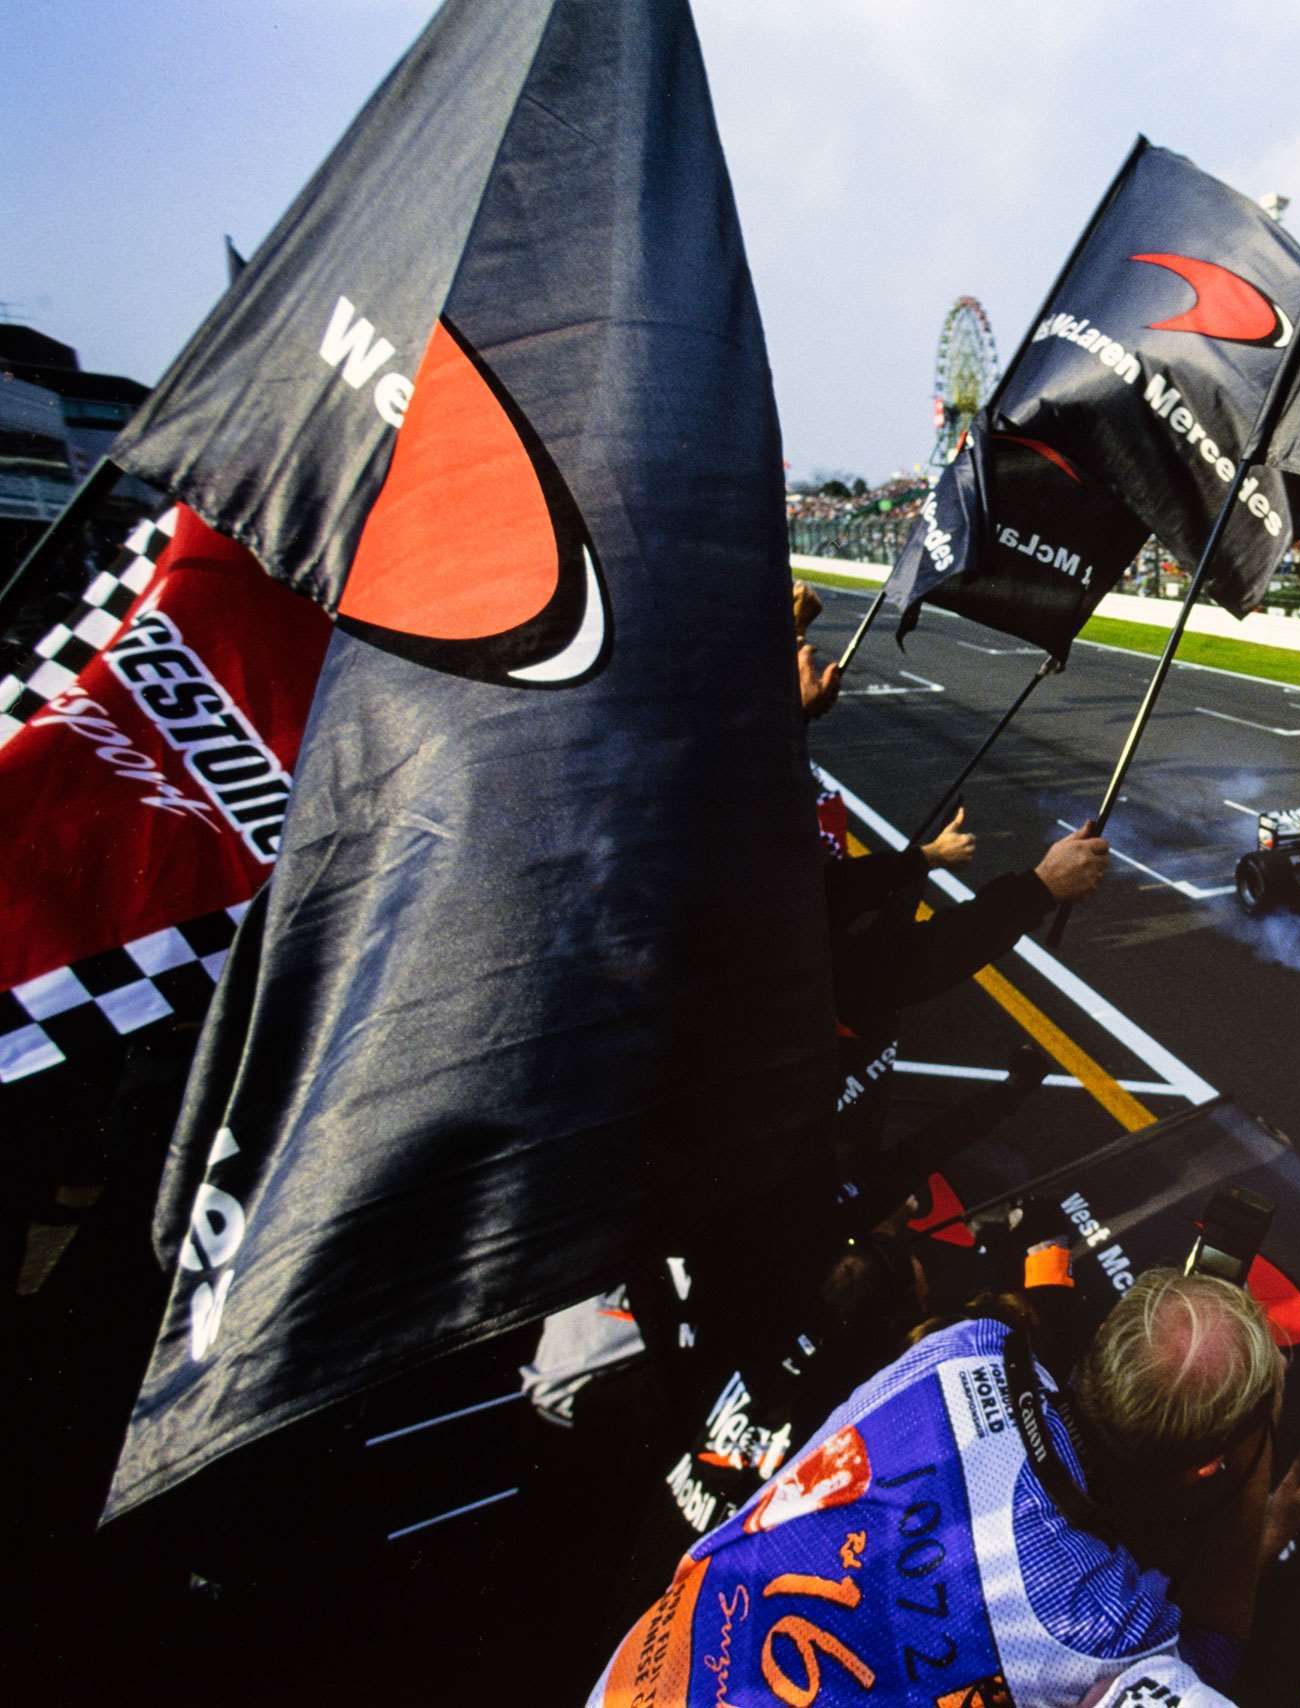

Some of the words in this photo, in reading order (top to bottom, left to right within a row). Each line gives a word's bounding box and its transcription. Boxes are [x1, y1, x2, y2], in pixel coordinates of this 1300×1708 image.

[1060, 1191, 1111, 1248] West
[1096, 1243, 1135, 1298] Mc
[971, 1365, 1005, 1434] WORLD
[1018, 1391, 1048, 1463] Canon
